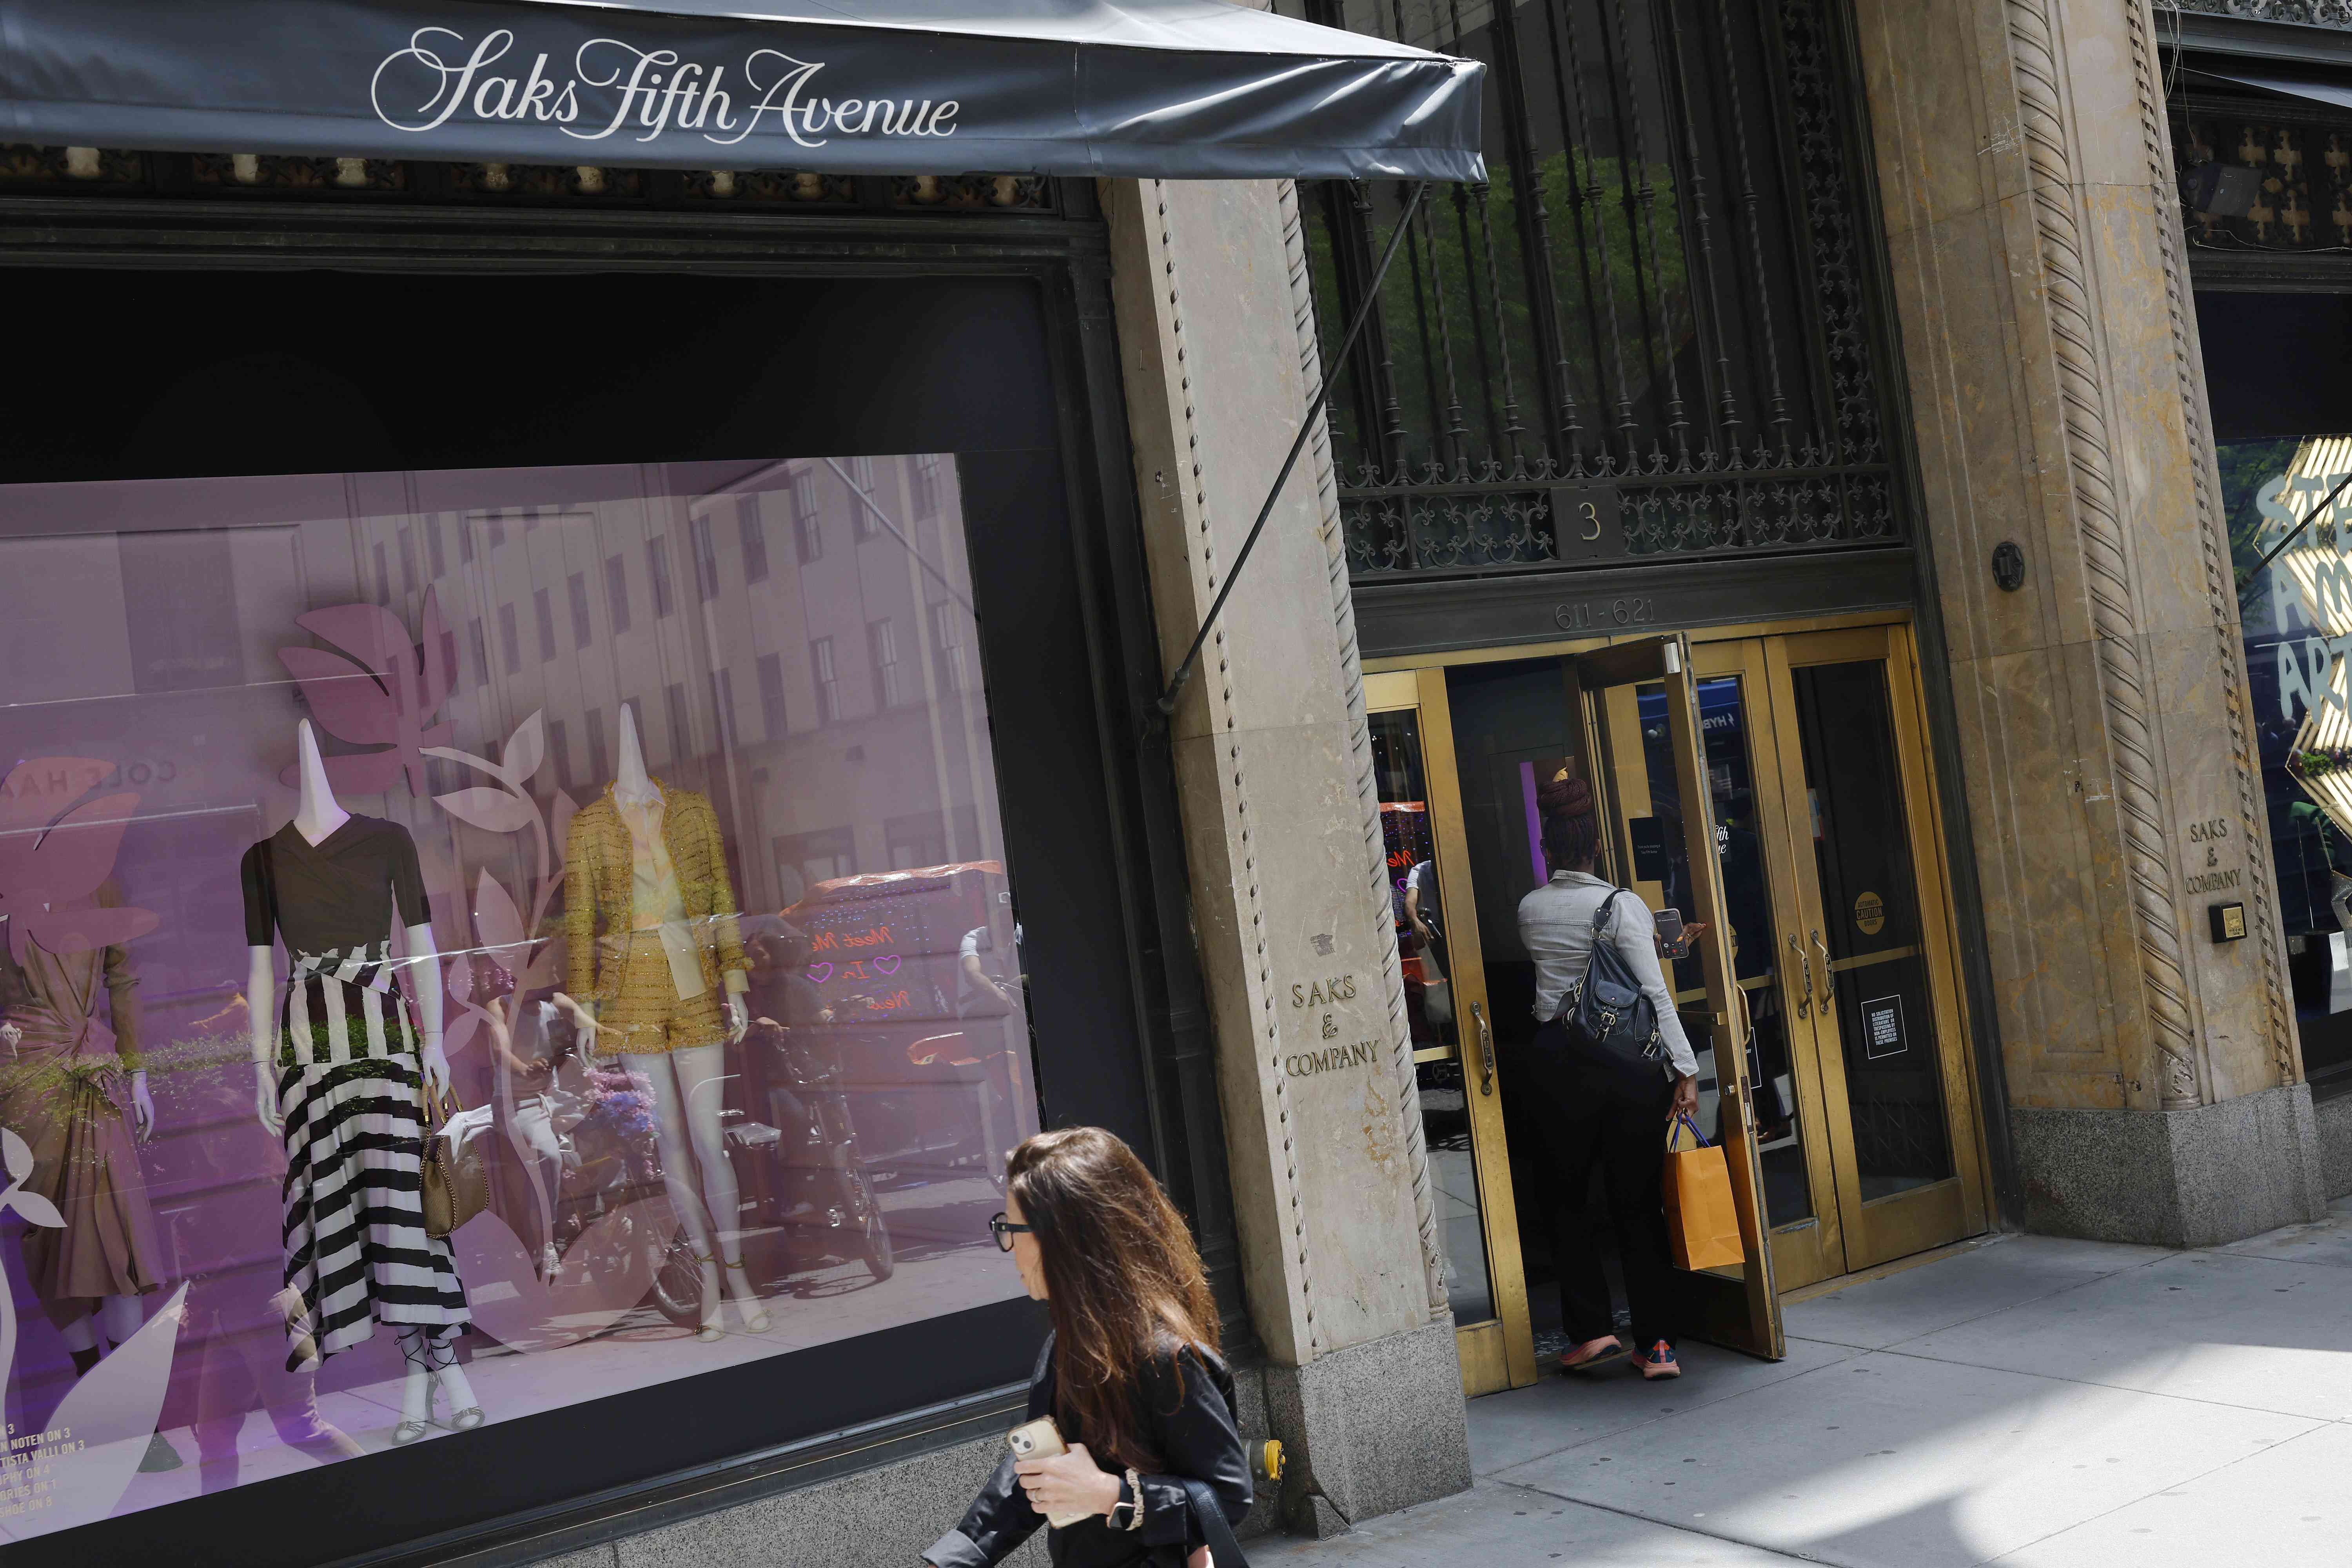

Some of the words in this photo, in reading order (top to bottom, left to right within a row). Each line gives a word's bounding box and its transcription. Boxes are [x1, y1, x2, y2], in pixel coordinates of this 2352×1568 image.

[371, 26, 580, 132] Saks
[560, 38, 738, 142] Fifth
[704, 49, 960, 148] Avenue
[1578, 502, 1601, 541] 3
[2190, 818, 2227, 842] SAKS
[2207, 847, 2218, 866] &
[2185, 869, 2241, 894] COMPANY
[1857, 907, 1882, 920] CAUTION
[1858, 899, 1879, 908] AUTOMATIC
[1864, 918, 1877, 927] DOORS
[1292, 973, 1356, 1008] SAKS
[1323, 1012, 1338, 1039] &
[1874, 1027, 1896, 1036] NON-EMPLOYEES
[1286, 1039, 1380, 1076] COMPANY
[7, 1423, 15, 1434] 3
[11, 1433, 44, 1450] NOTEN
[47, 1429, 61, 1442] ON
[64, 1427, 71, 1438] 3
[31, 1446, 59, 1461] VALLI
[61, 1442, 75, 1454] ON
[78, 1440, 85, 1450] 3
[0, 1470, 22, 1485] PHY
[26, 1466, 40, 1479] ON
[34, 1481, 48, 1493] ON
[29, 1498, 44, 1510] ON
